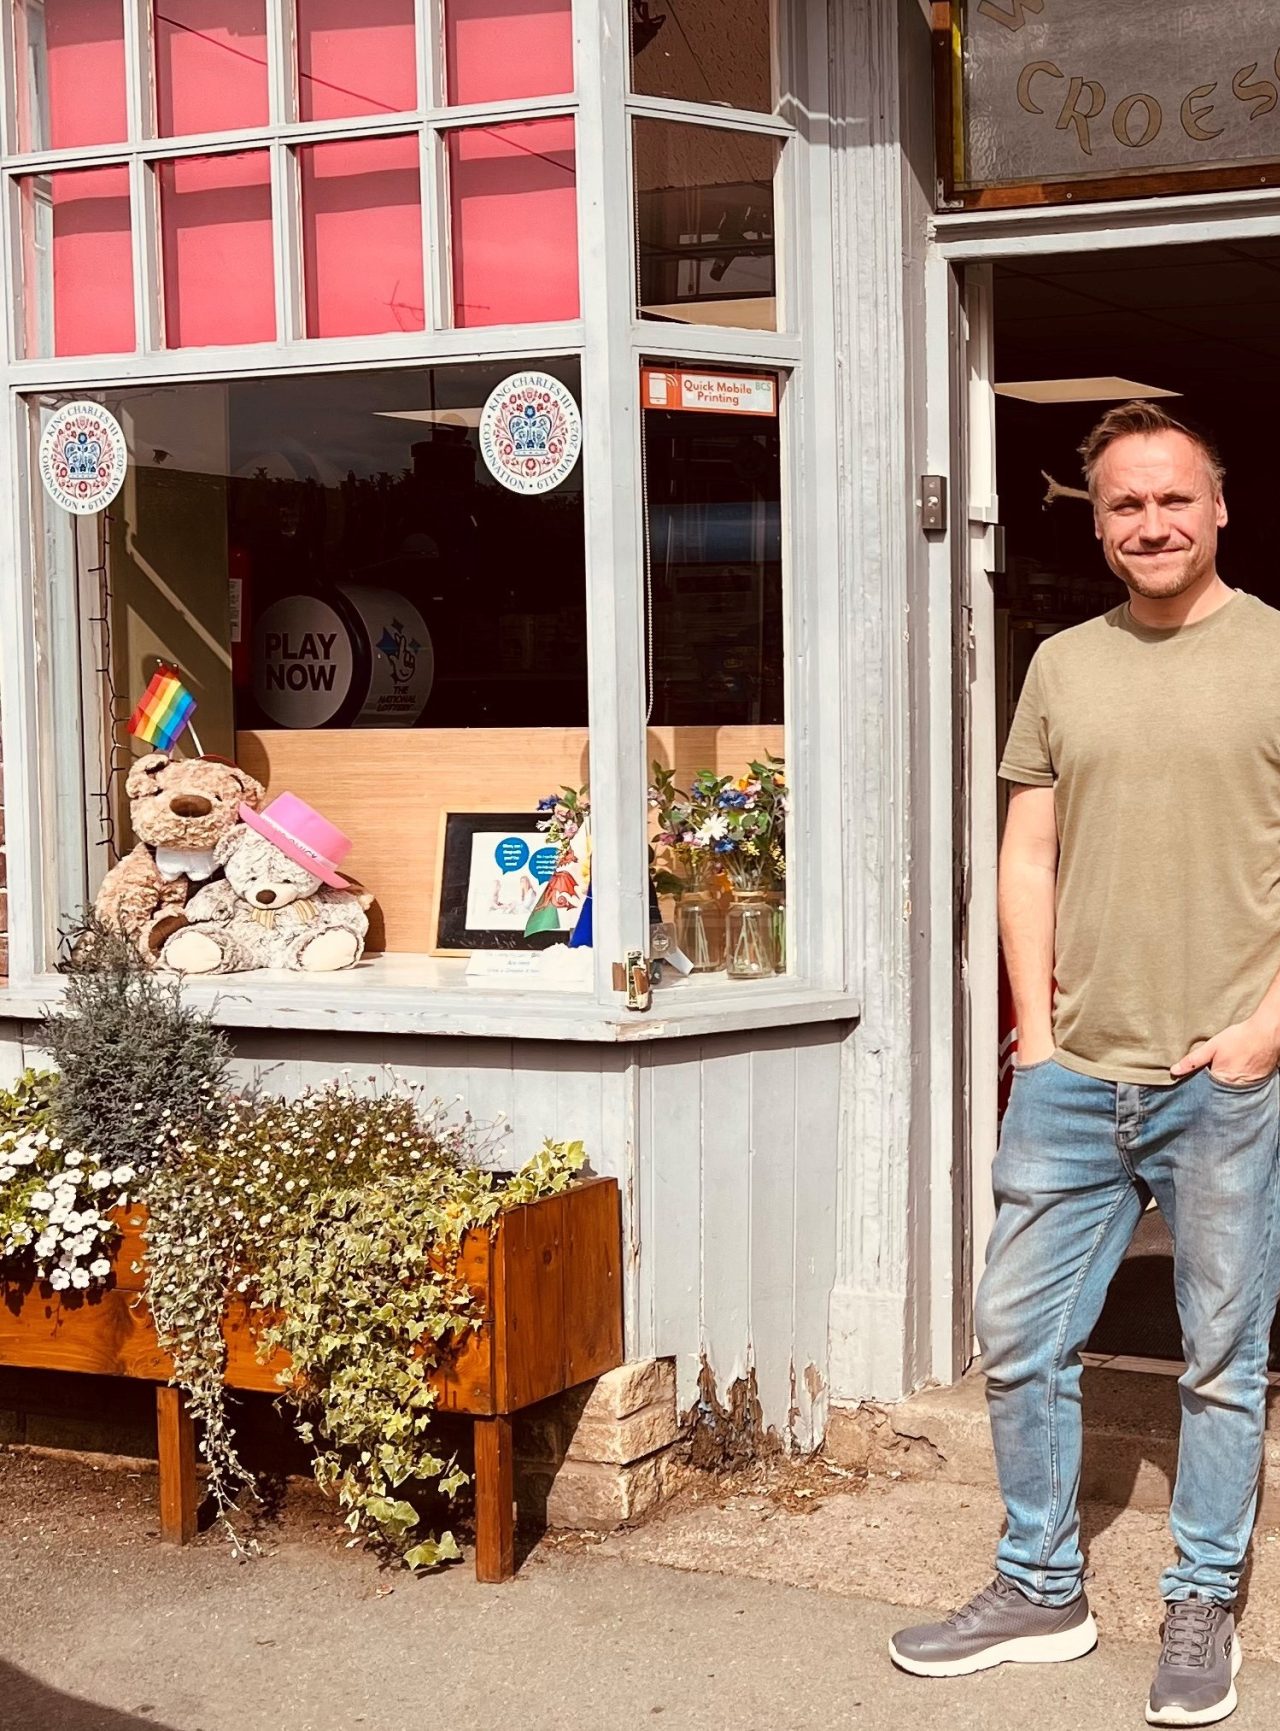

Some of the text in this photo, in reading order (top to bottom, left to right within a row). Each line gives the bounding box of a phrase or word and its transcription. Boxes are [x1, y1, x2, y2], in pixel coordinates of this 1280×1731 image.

[489, 376, 572, 412] KING CHARLES III
[683, 379, 771, 395] Quick Mobile BCS
[697, 391, 739, 406] Printing
[47, 405, 119, 437] KING CHARLES III
[483, 423, 525, 490] CORONATION
[536, 419, 579, 490] 6TH MAY 2023
[42, 448, 78, 510] CORONATION
[88, 496, 106, 510] 6TH
[106, 478, 121, 498] MAY
[264, 632, 338, 660] PLAY
[265, 664, 336, 691] NOW
[393, 685, 409, 694] THE
[378, 695, 416, 704] NATIONAL
